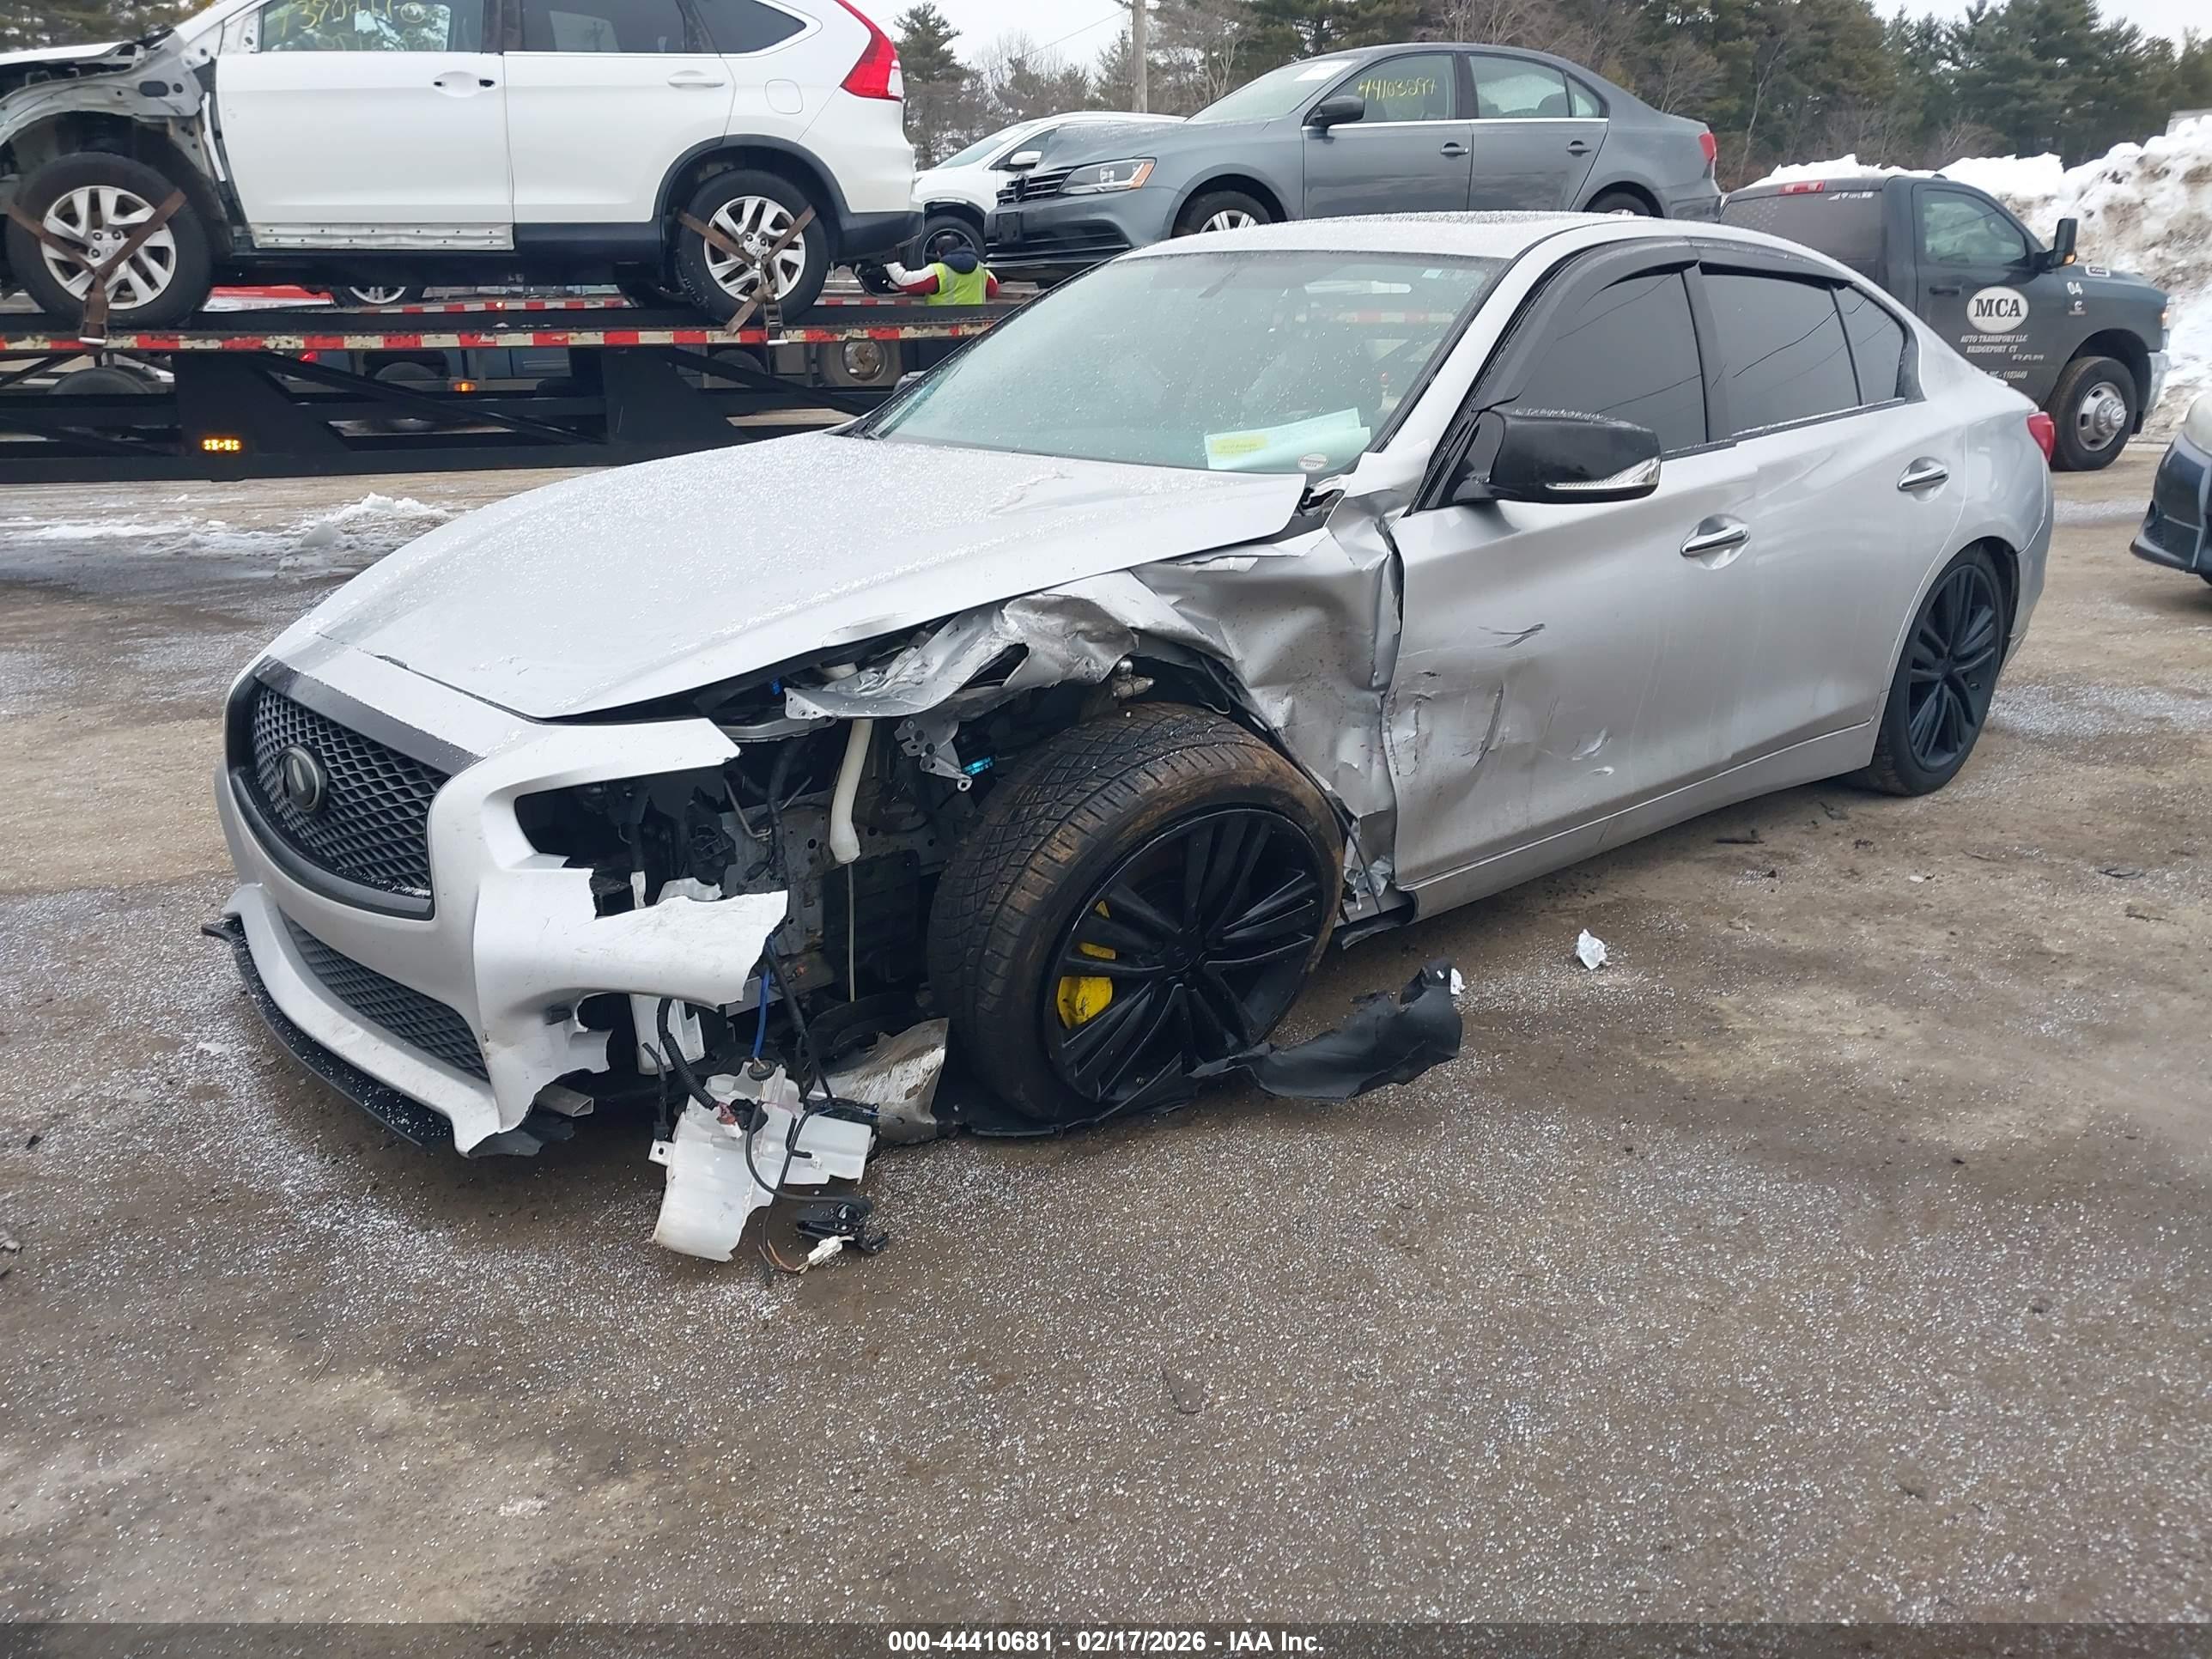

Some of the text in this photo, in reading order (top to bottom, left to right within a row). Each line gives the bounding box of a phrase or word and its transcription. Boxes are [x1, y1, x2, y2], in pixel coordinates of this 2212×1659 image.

[2067, 281, 2083, 295] 04
[1973, 298, 2022, 318] MCA
[2014, 334, 2028, 343] LLC
